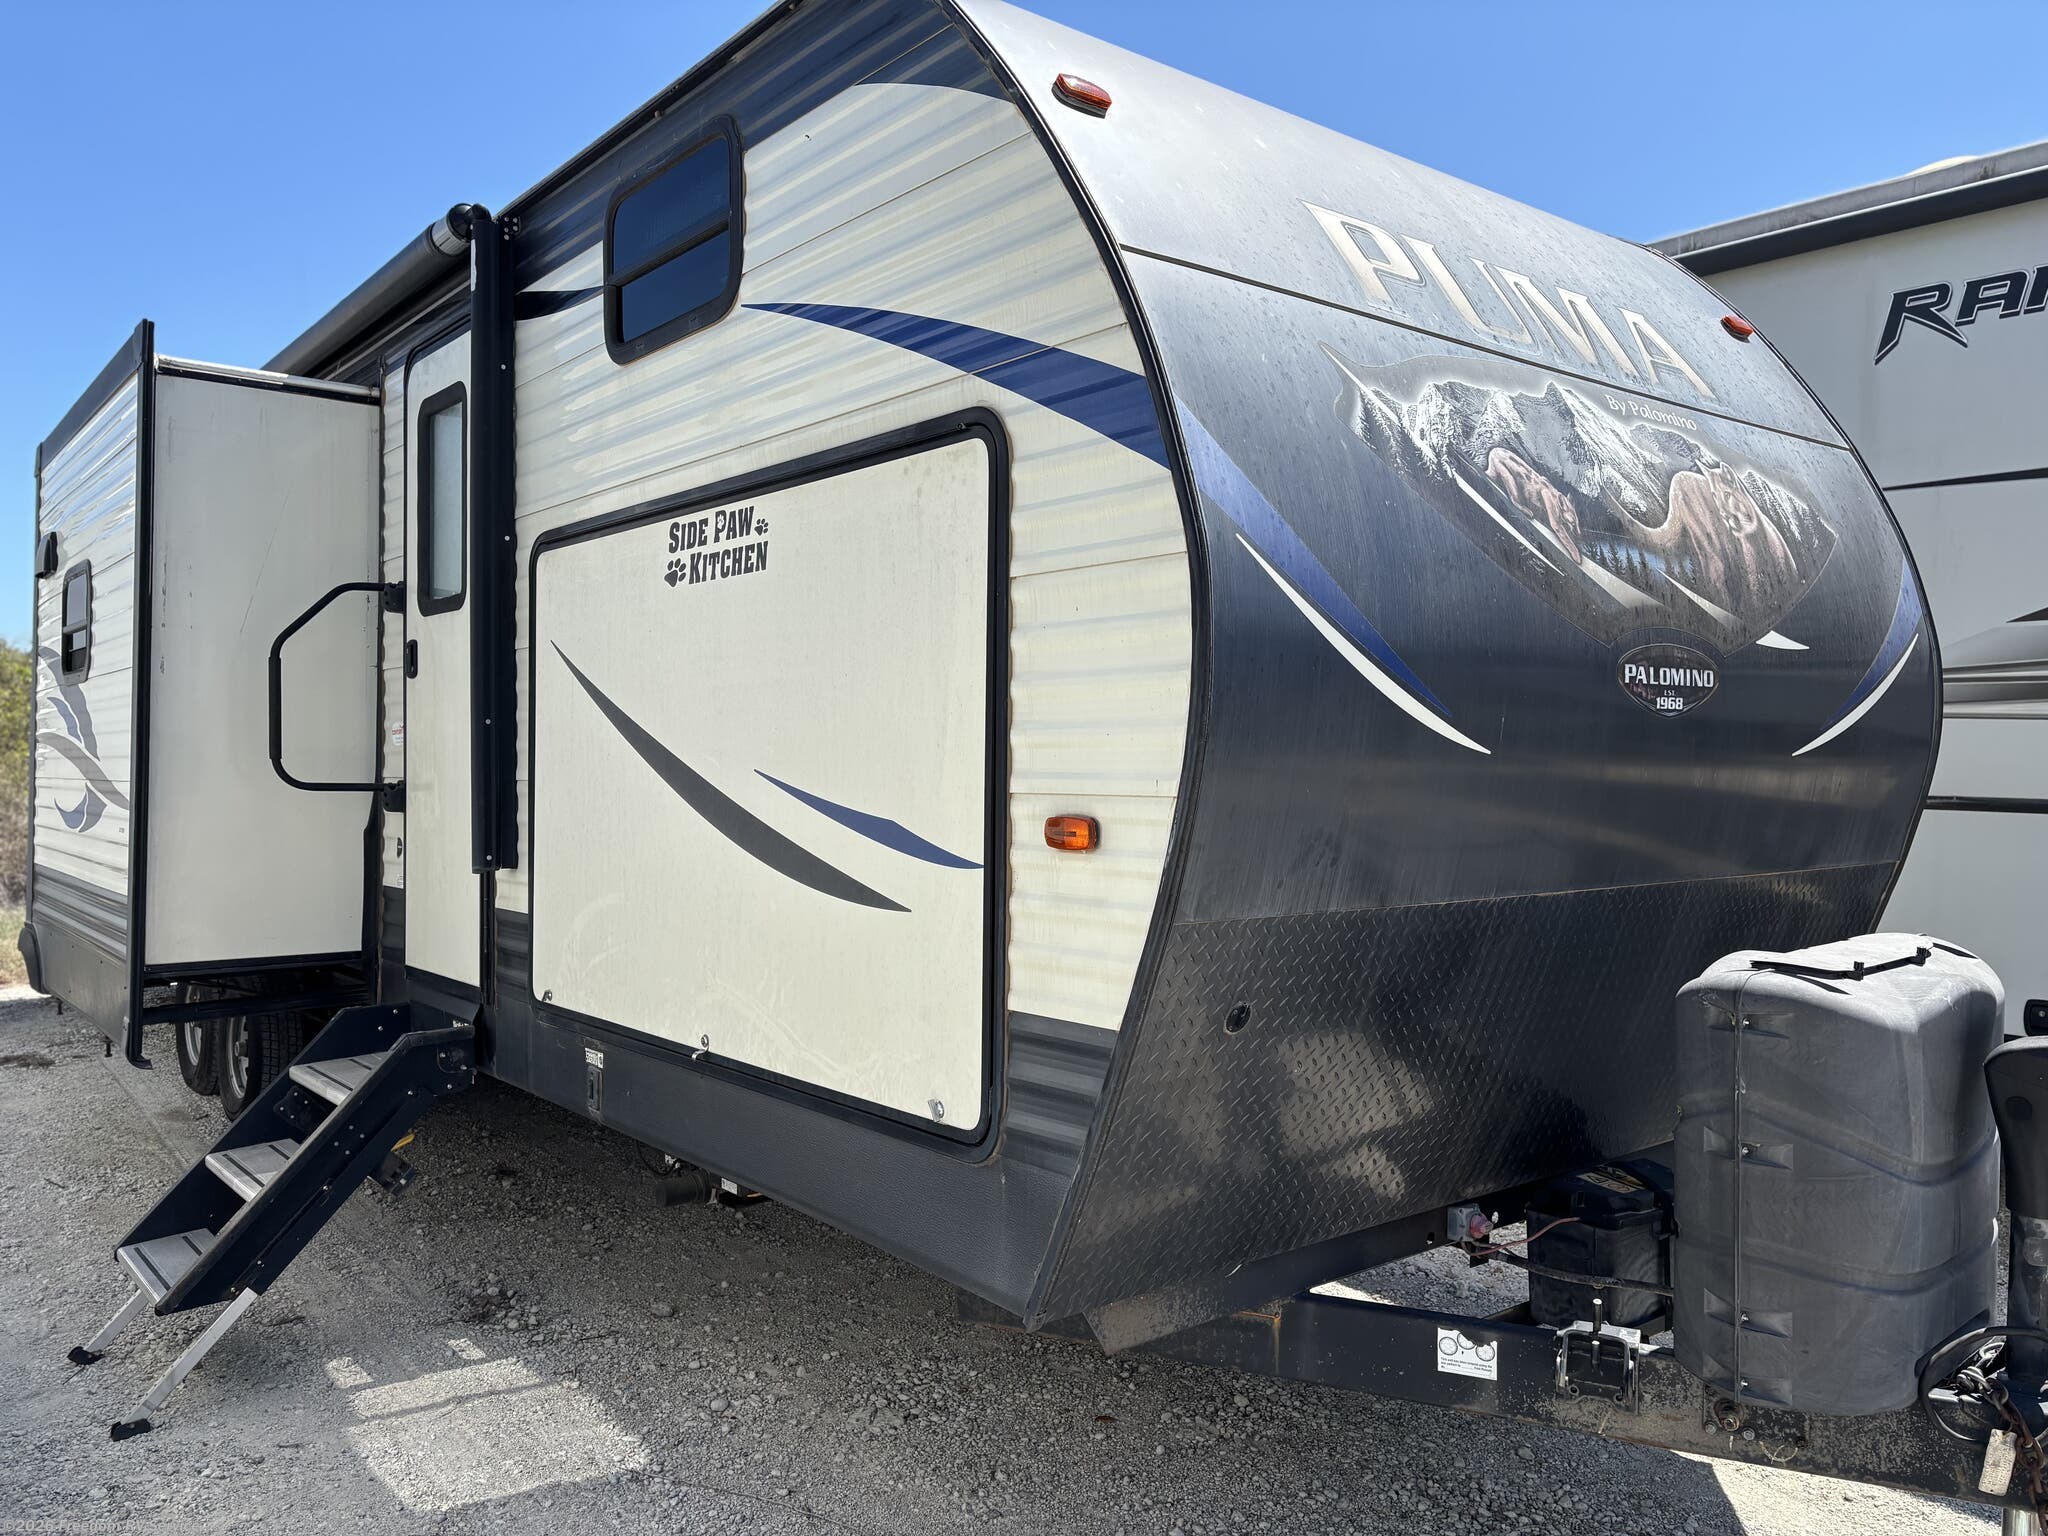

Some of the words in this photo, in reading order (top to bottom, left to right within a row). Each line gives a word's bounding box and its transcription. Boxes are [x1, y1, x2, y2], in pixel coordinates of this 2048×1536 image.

[1297, 198, 1728, 408] PUMA
[1604, 394, 1627, 416] By
[1627, 400, 1697, 431] Palomino
[668, 517, 709, 554] SIDE
[713, 505, 755, 544] PAW
[688, 540, 769, 585] KITCHEN
[1625, 663, 1714, 687] PALOMINO
[1656, 697, 1683, 710] 1968
